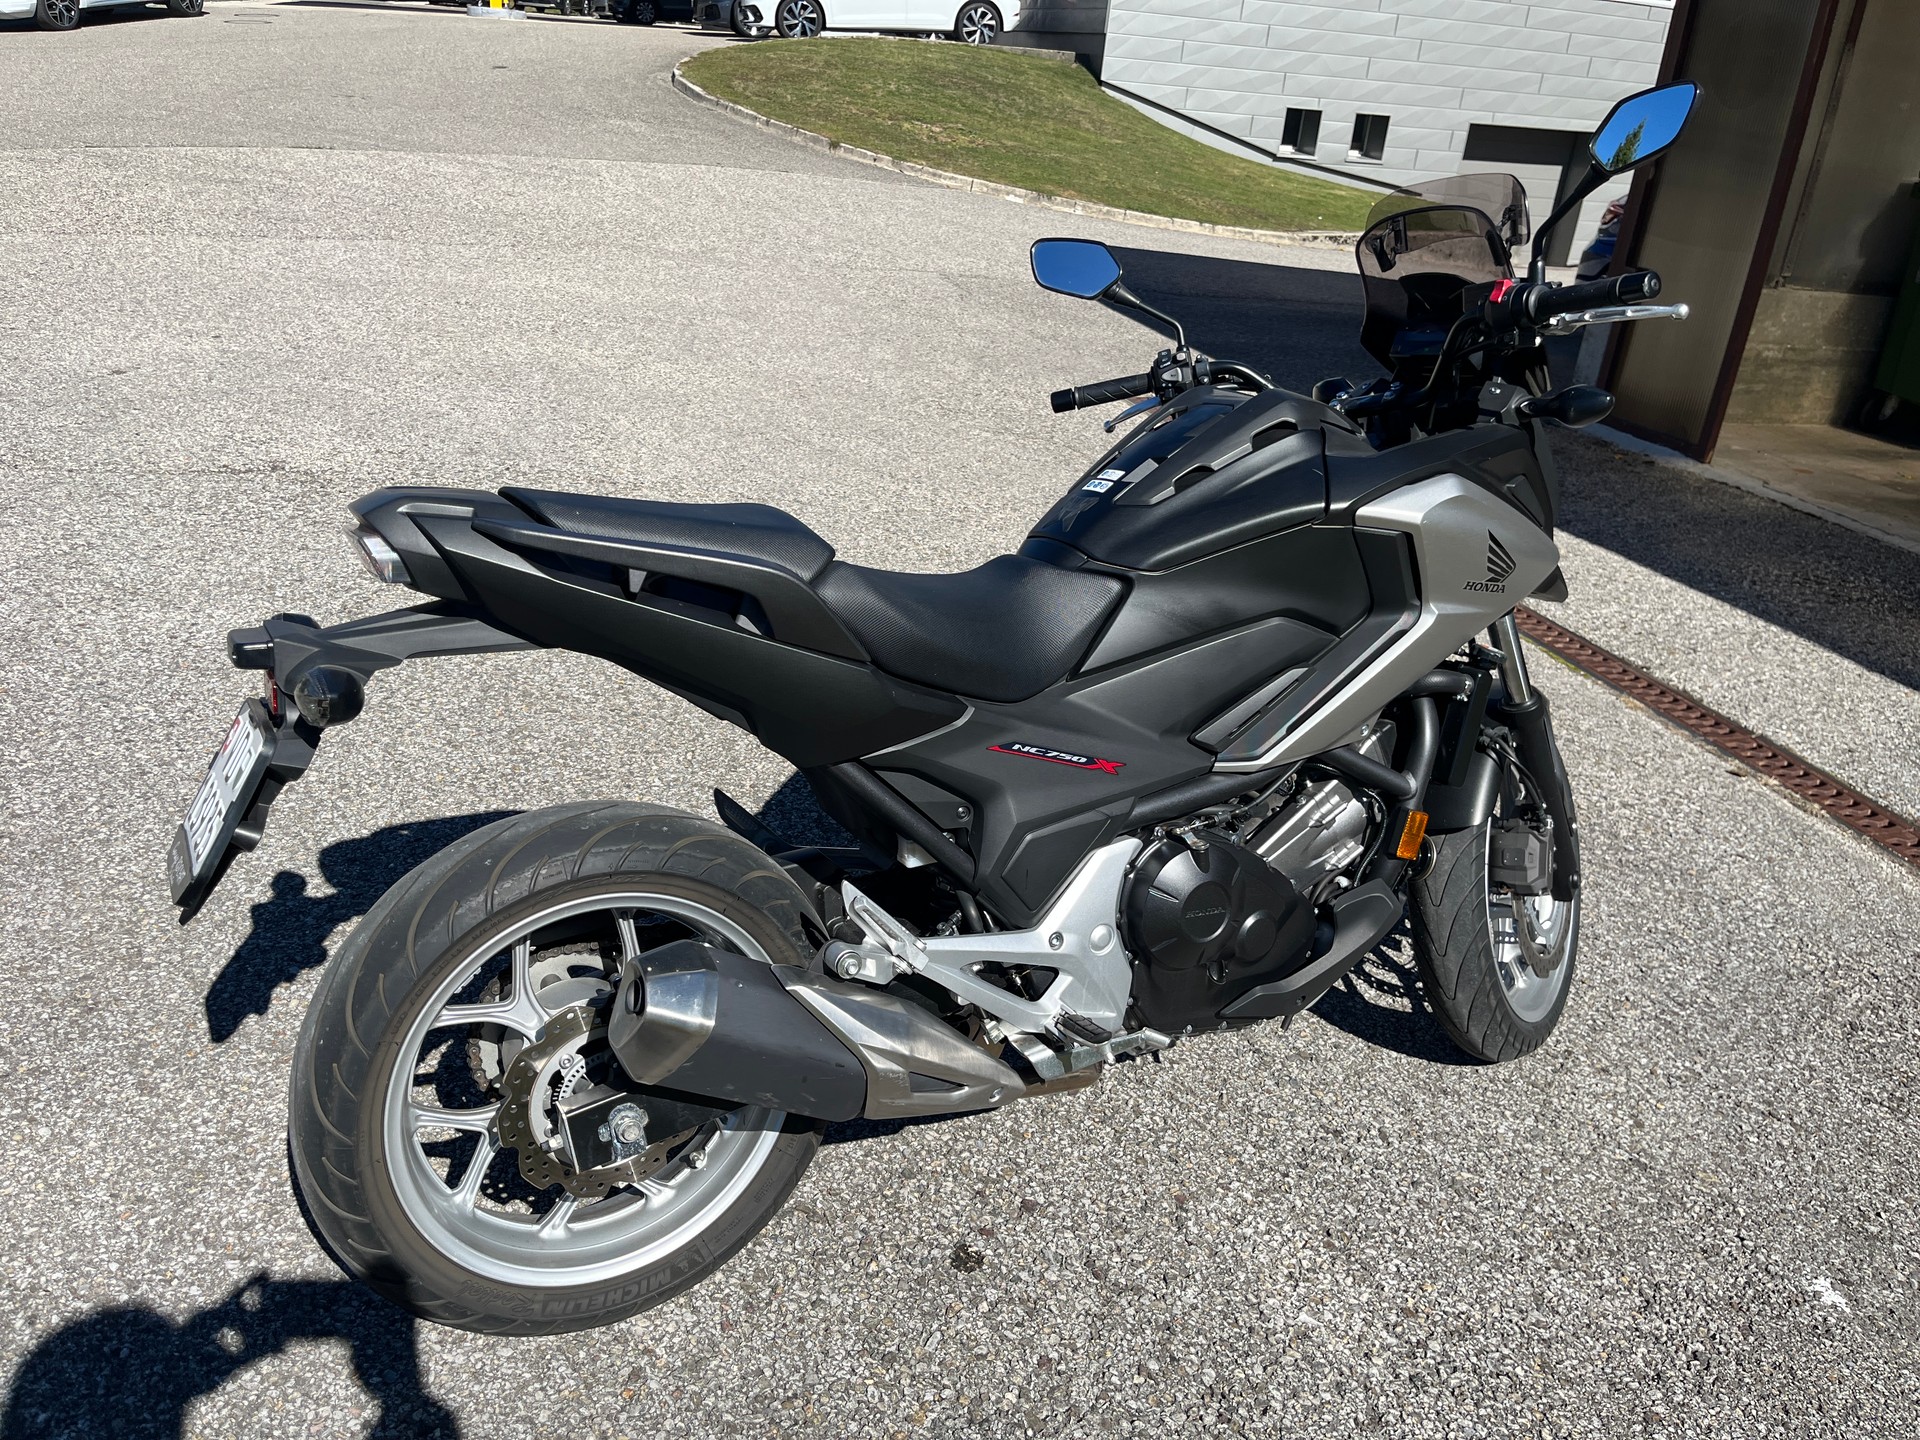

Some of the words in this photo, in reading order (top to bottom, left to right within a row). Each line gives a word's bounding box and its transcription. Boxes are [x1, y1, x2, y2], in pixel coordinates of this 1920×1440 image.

[1463, 581, 1506, 594] HONDA
[222, 722, 252, 784] VD
[187, 772, 223, 863] 13935
[1185, 906, 1226, 919] HONDA
[455, 1279, 535, 1318] Radial
[544, 1268, 671, 1316] MICHELIN
